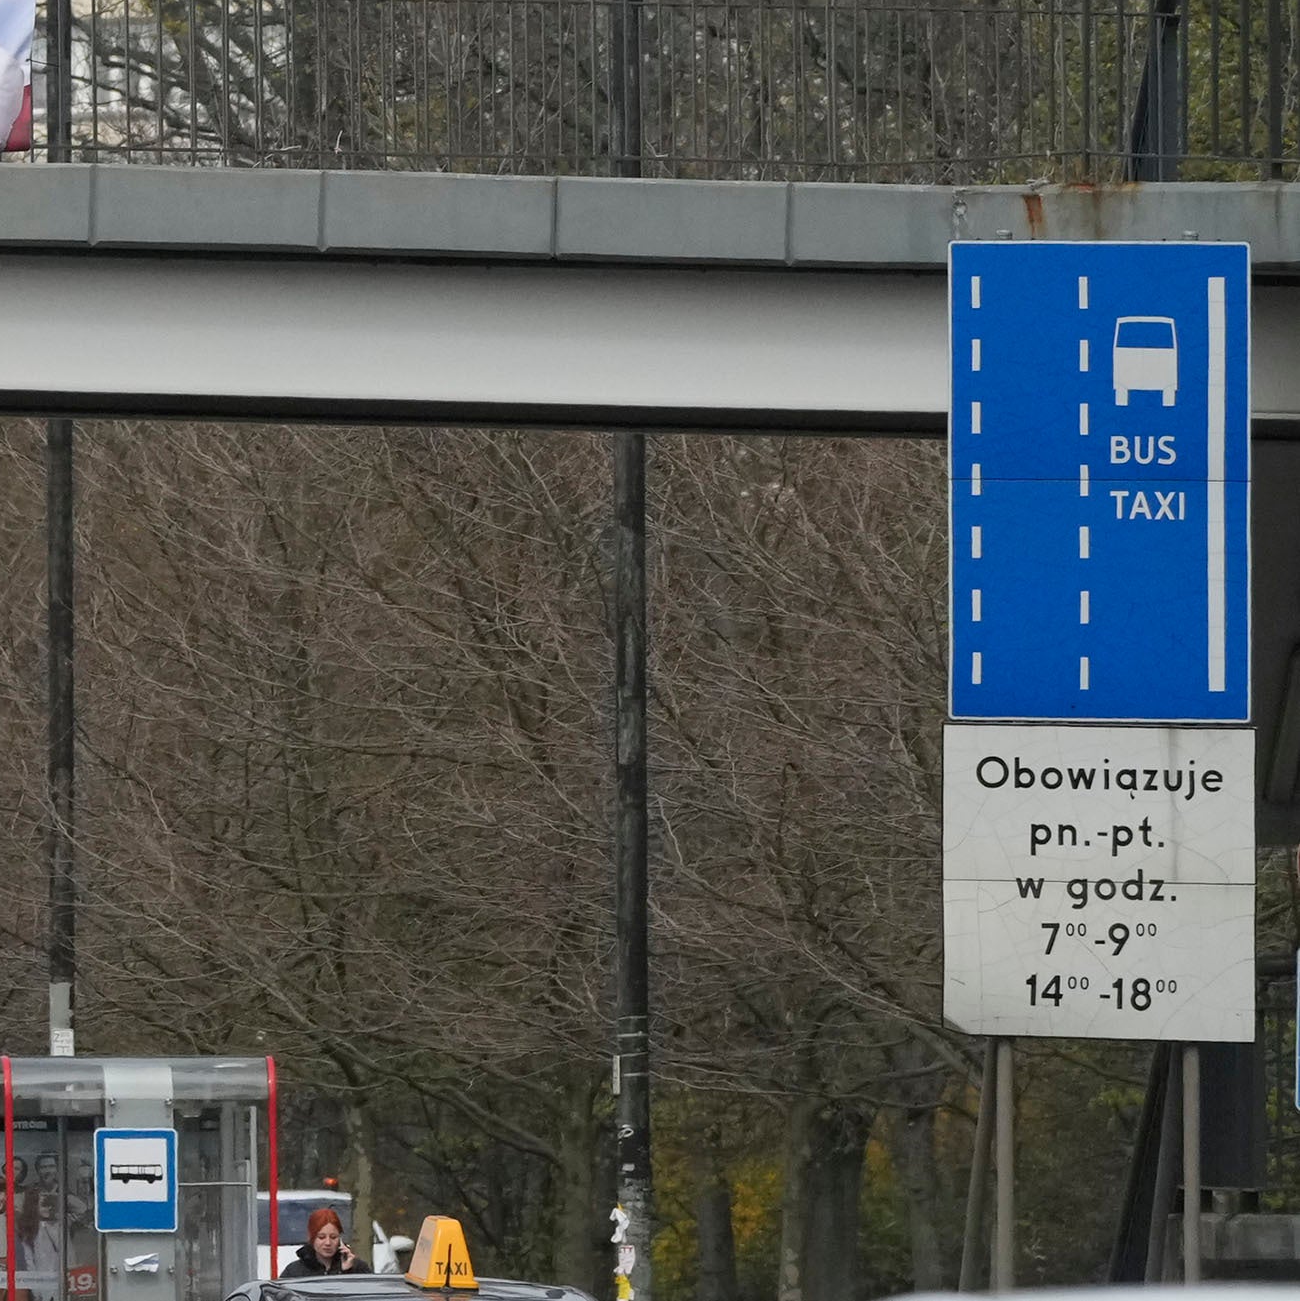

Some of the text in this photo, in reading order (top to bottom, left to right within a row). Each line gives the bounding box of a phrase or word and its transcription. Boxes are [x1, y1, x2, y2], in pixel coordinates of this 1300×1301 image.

[1110, 436, 1177, 465] BUS
[1110, 491, 1186, 521] TAXI
[975, 756, 1225, 801] Obowiązuje
[1029, 817, 1166, 859] pn.-pt.
[1015, 869, 1178, 910] w godz.
[435, 1262, 467, 1276] TAXI
